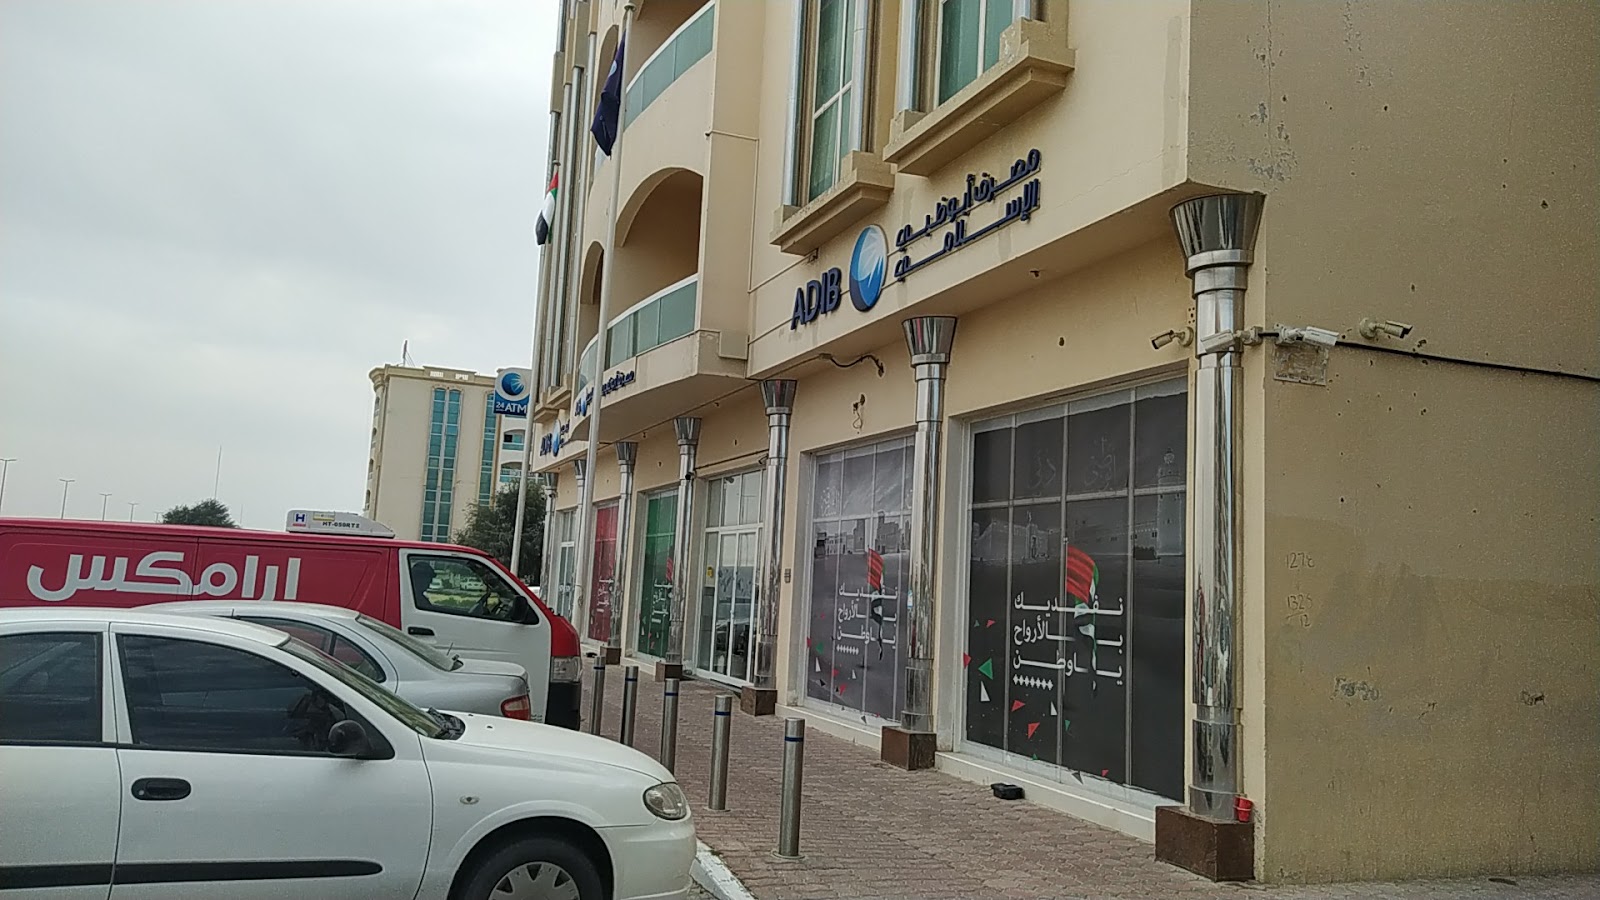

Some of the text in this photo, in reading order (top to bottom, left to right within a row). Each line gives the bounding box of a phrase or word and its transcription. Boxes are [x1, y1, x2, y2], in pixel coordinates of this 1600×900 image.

[974, 148, 1041, 202] مصرف
[894, 178, 1041, 282] الإسلامي
[791, 268, 842, 330] ADIB
[504, 402, 527, 413] ATM
[295, 513, 305, 522] H
[27, 551, 301, 601] ارامكس
[1015, 592, 1124, 616] نفديك
